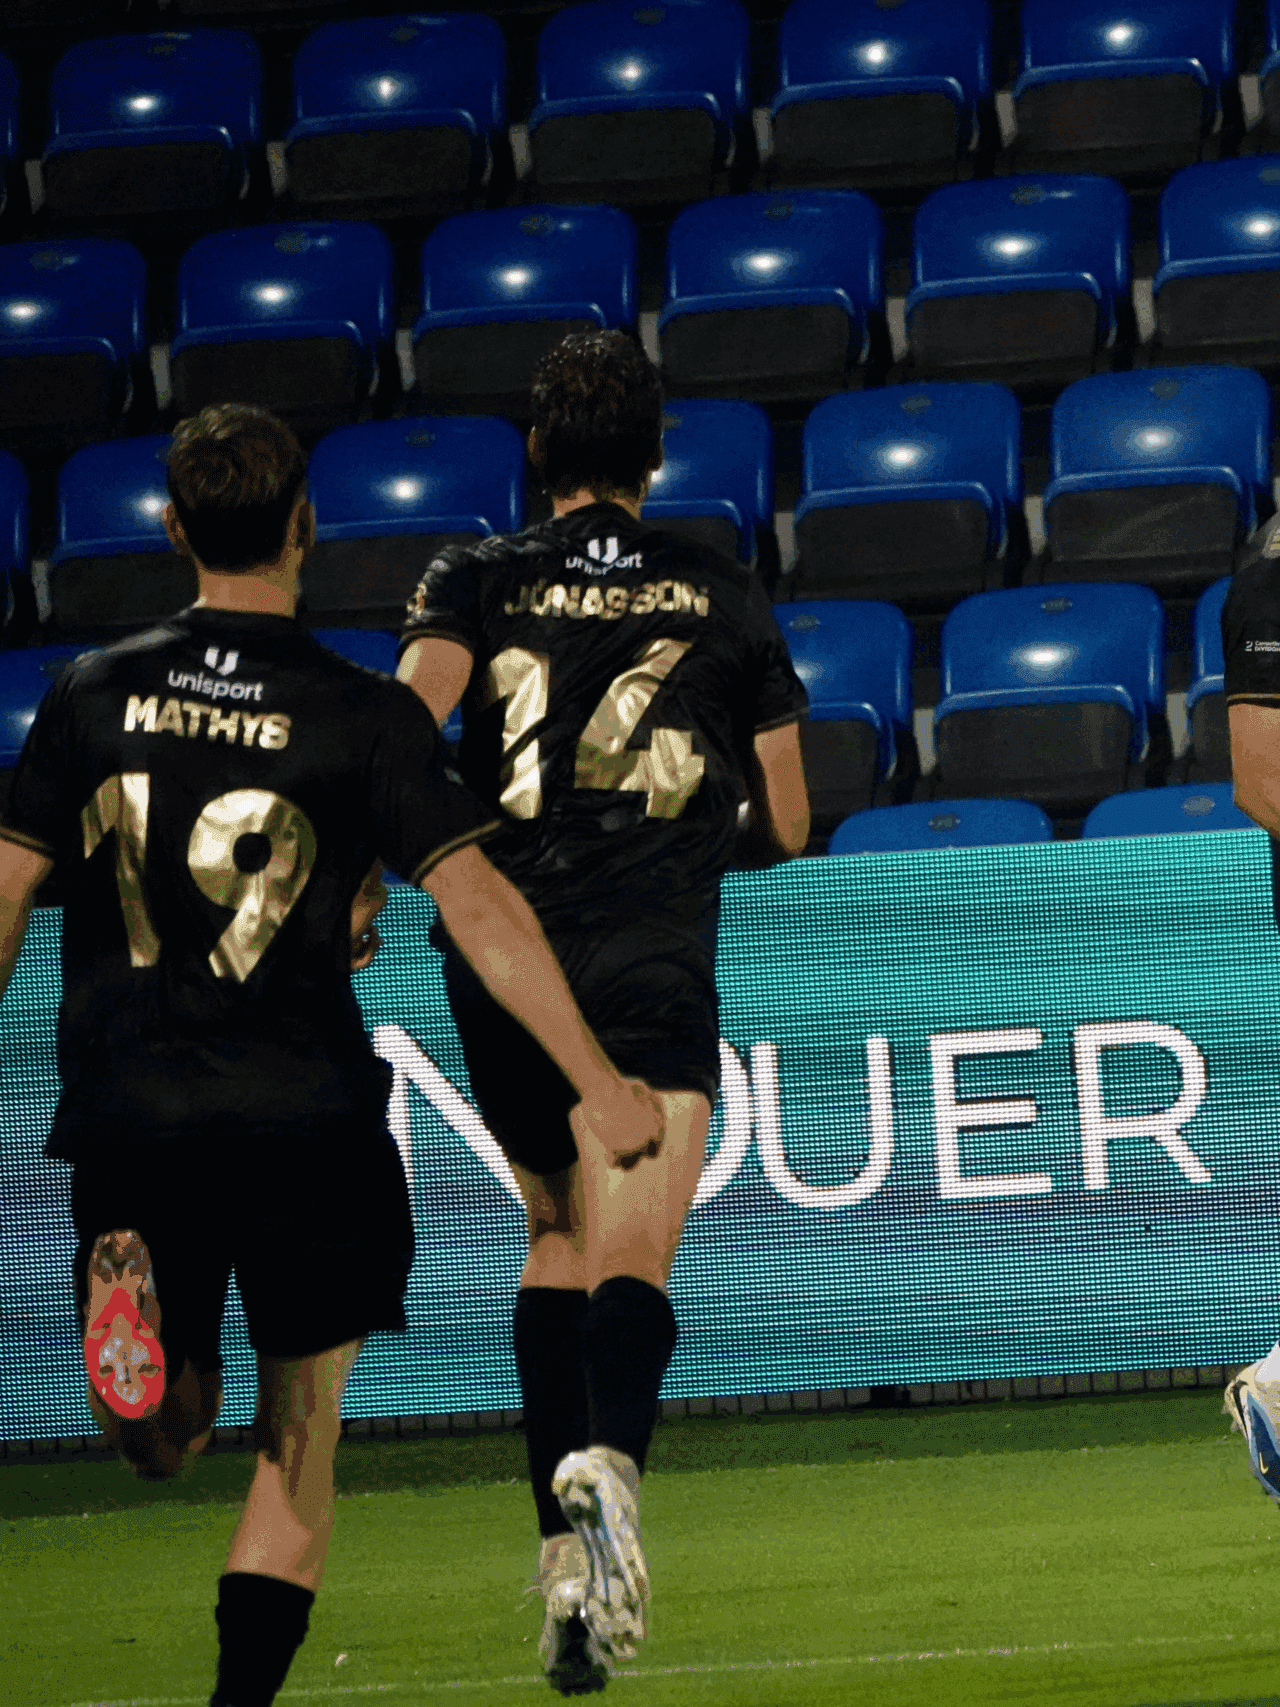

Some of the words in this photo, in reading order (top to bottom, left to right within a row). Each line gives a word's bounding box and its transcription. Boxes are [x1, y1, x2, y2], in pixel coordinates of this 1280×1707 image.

[123, 694, 292, 750] MATHYS
[166, 669, 264, 701] unisport
[486, 637, 706, 820] 14
[81, 771, 318, 983] 19
